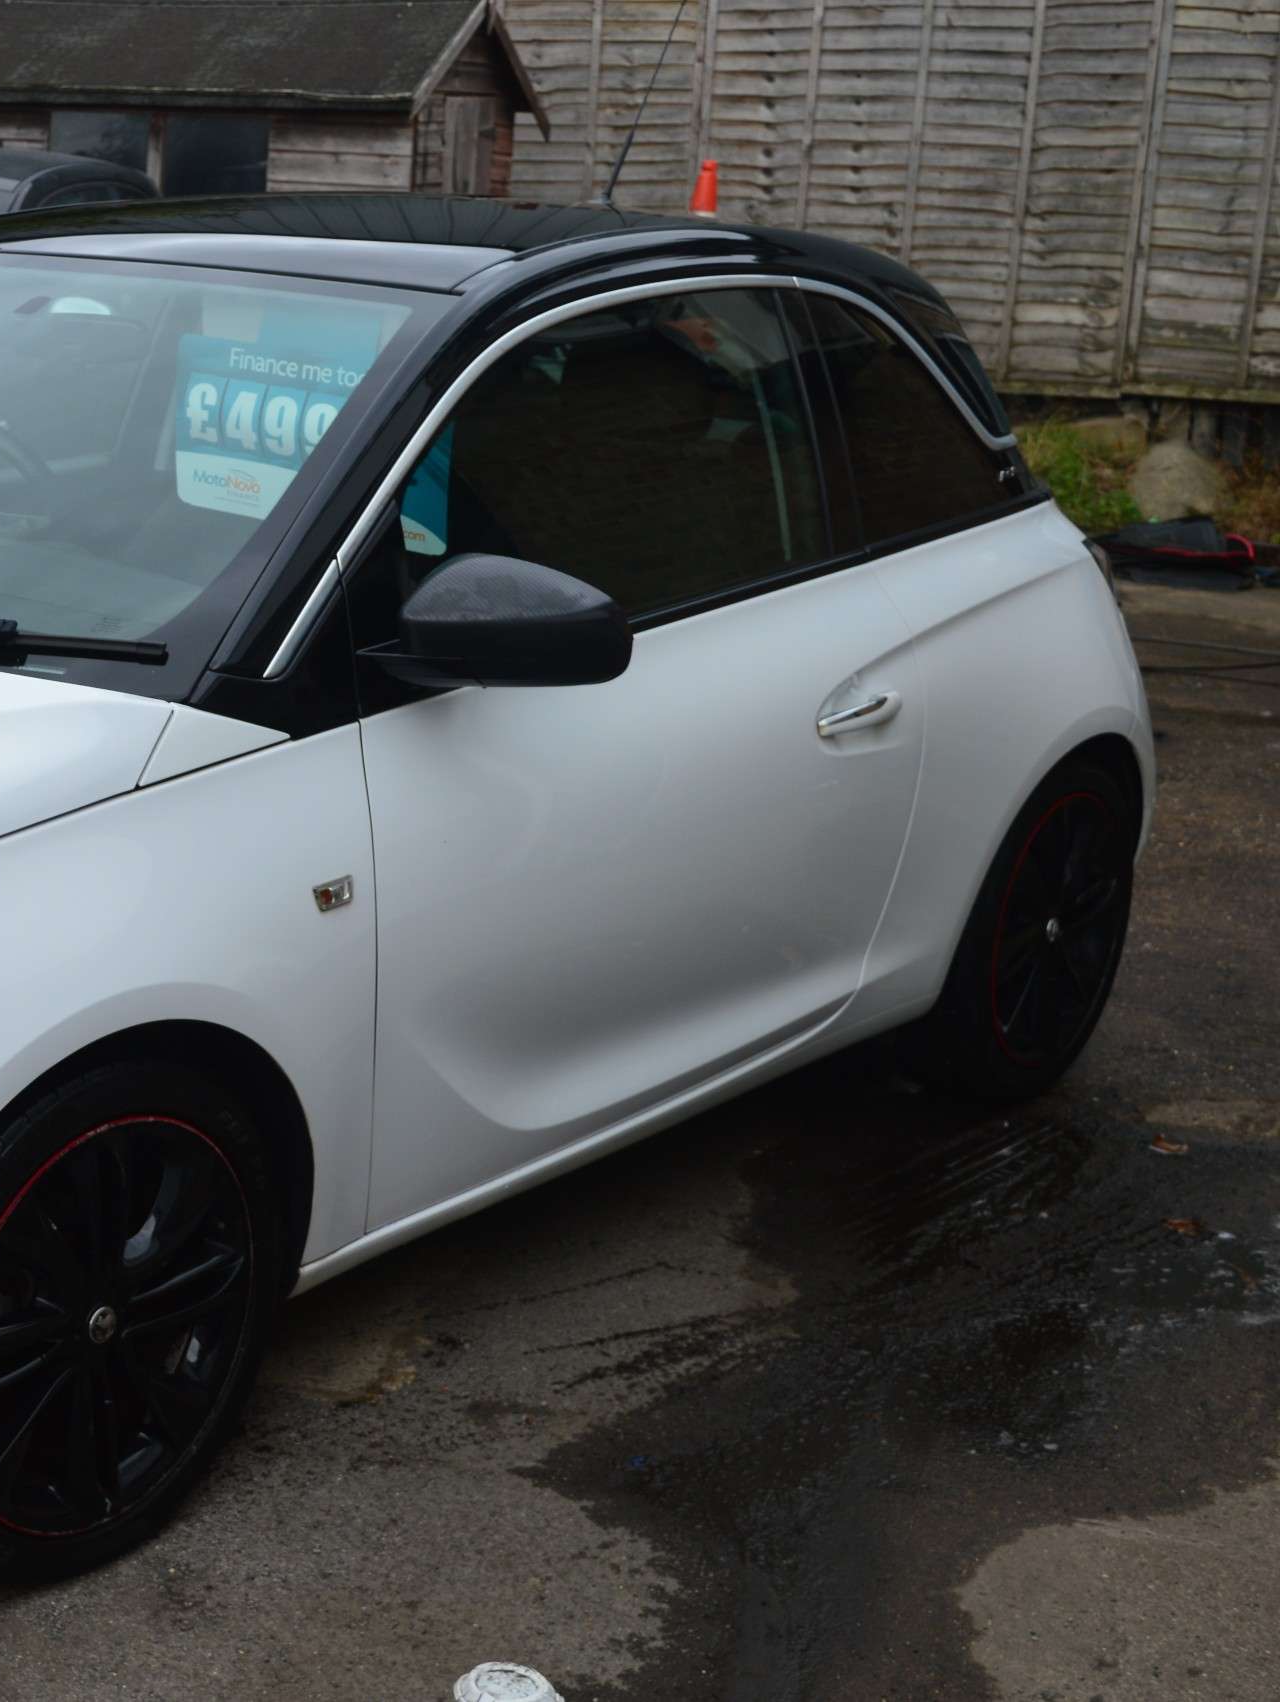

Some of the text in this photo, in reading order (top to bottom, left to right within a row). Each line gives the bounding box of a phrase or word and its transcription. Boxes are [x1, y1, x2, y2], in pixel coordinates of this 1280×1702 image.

[228, 347, 298, 378] Finance
[302, 364, 332, 384] me
[186, 383, 339, 456] £499
